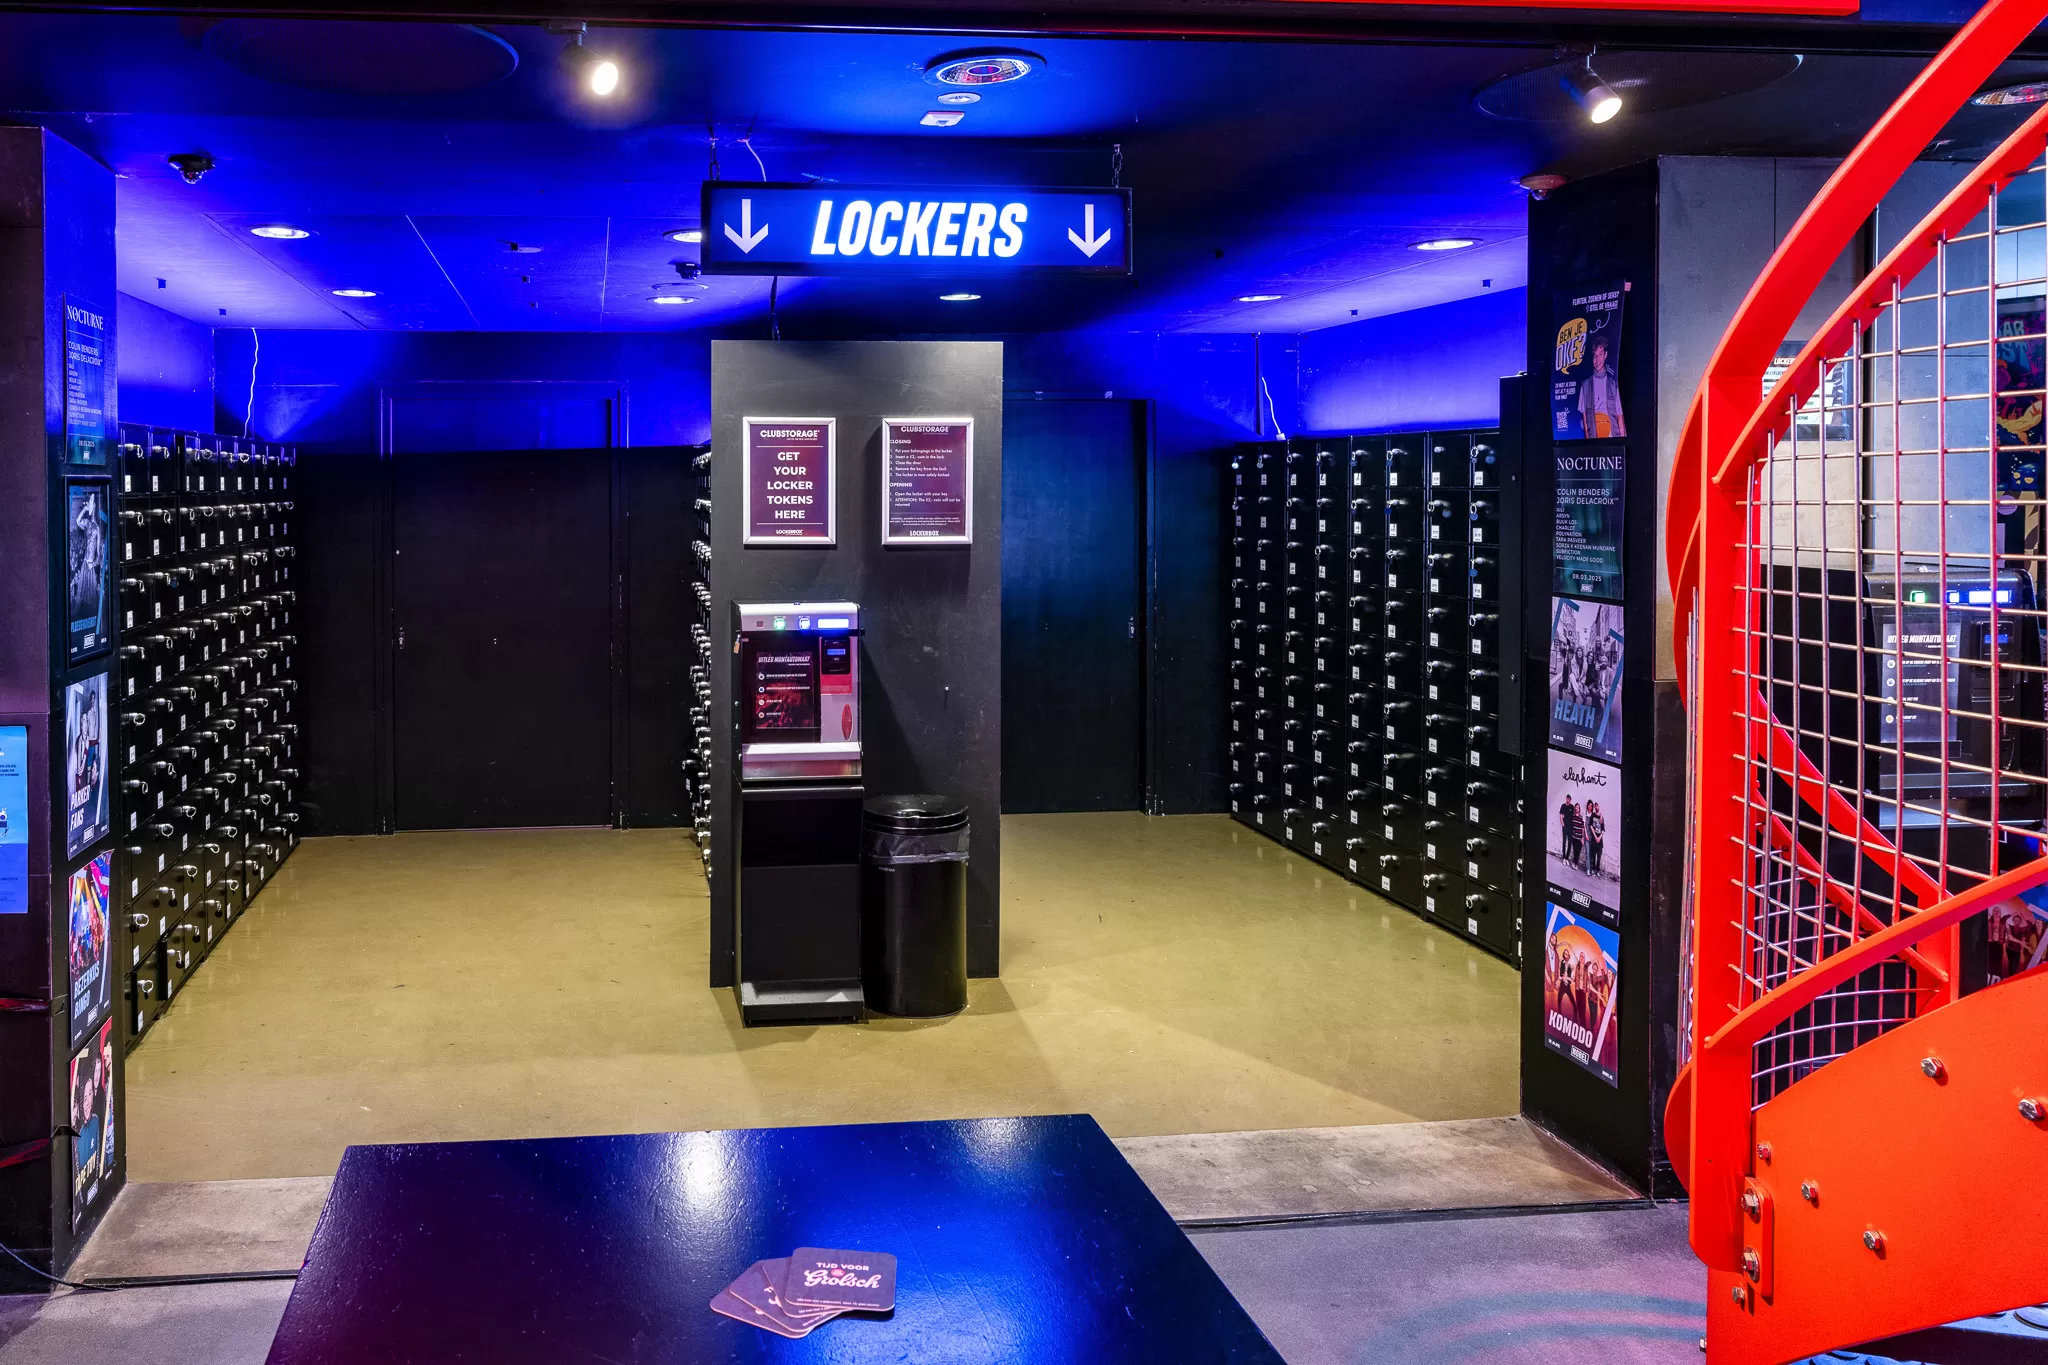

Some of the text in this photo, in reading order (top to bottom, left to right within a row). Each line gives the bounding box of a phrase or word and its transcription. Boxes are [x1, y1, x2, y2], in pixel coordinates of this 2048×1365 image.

[810, 200, 1029, 258] LOCKERS
[1559, 320, 1584, 343] BEN JE
[760, 430, 819, 438] CLUBSTORAGE
[777, 452, 800, 461] GET
[774, 467, 806, 475] YOUR
[767, 481, 813, 490] LOCKER
[767, 496, 813, 505] TOKENS
[775, 510, 806, 519] HERE
[1554, 700, 1596, 729] HEATH
[1562, 766, 1607, 788] elephant
[71, 808, 84, 831] FANS
[1549, 1009, 1593, 1048] KOMODO
[804, 1269, 882, 1289] Grolsch
